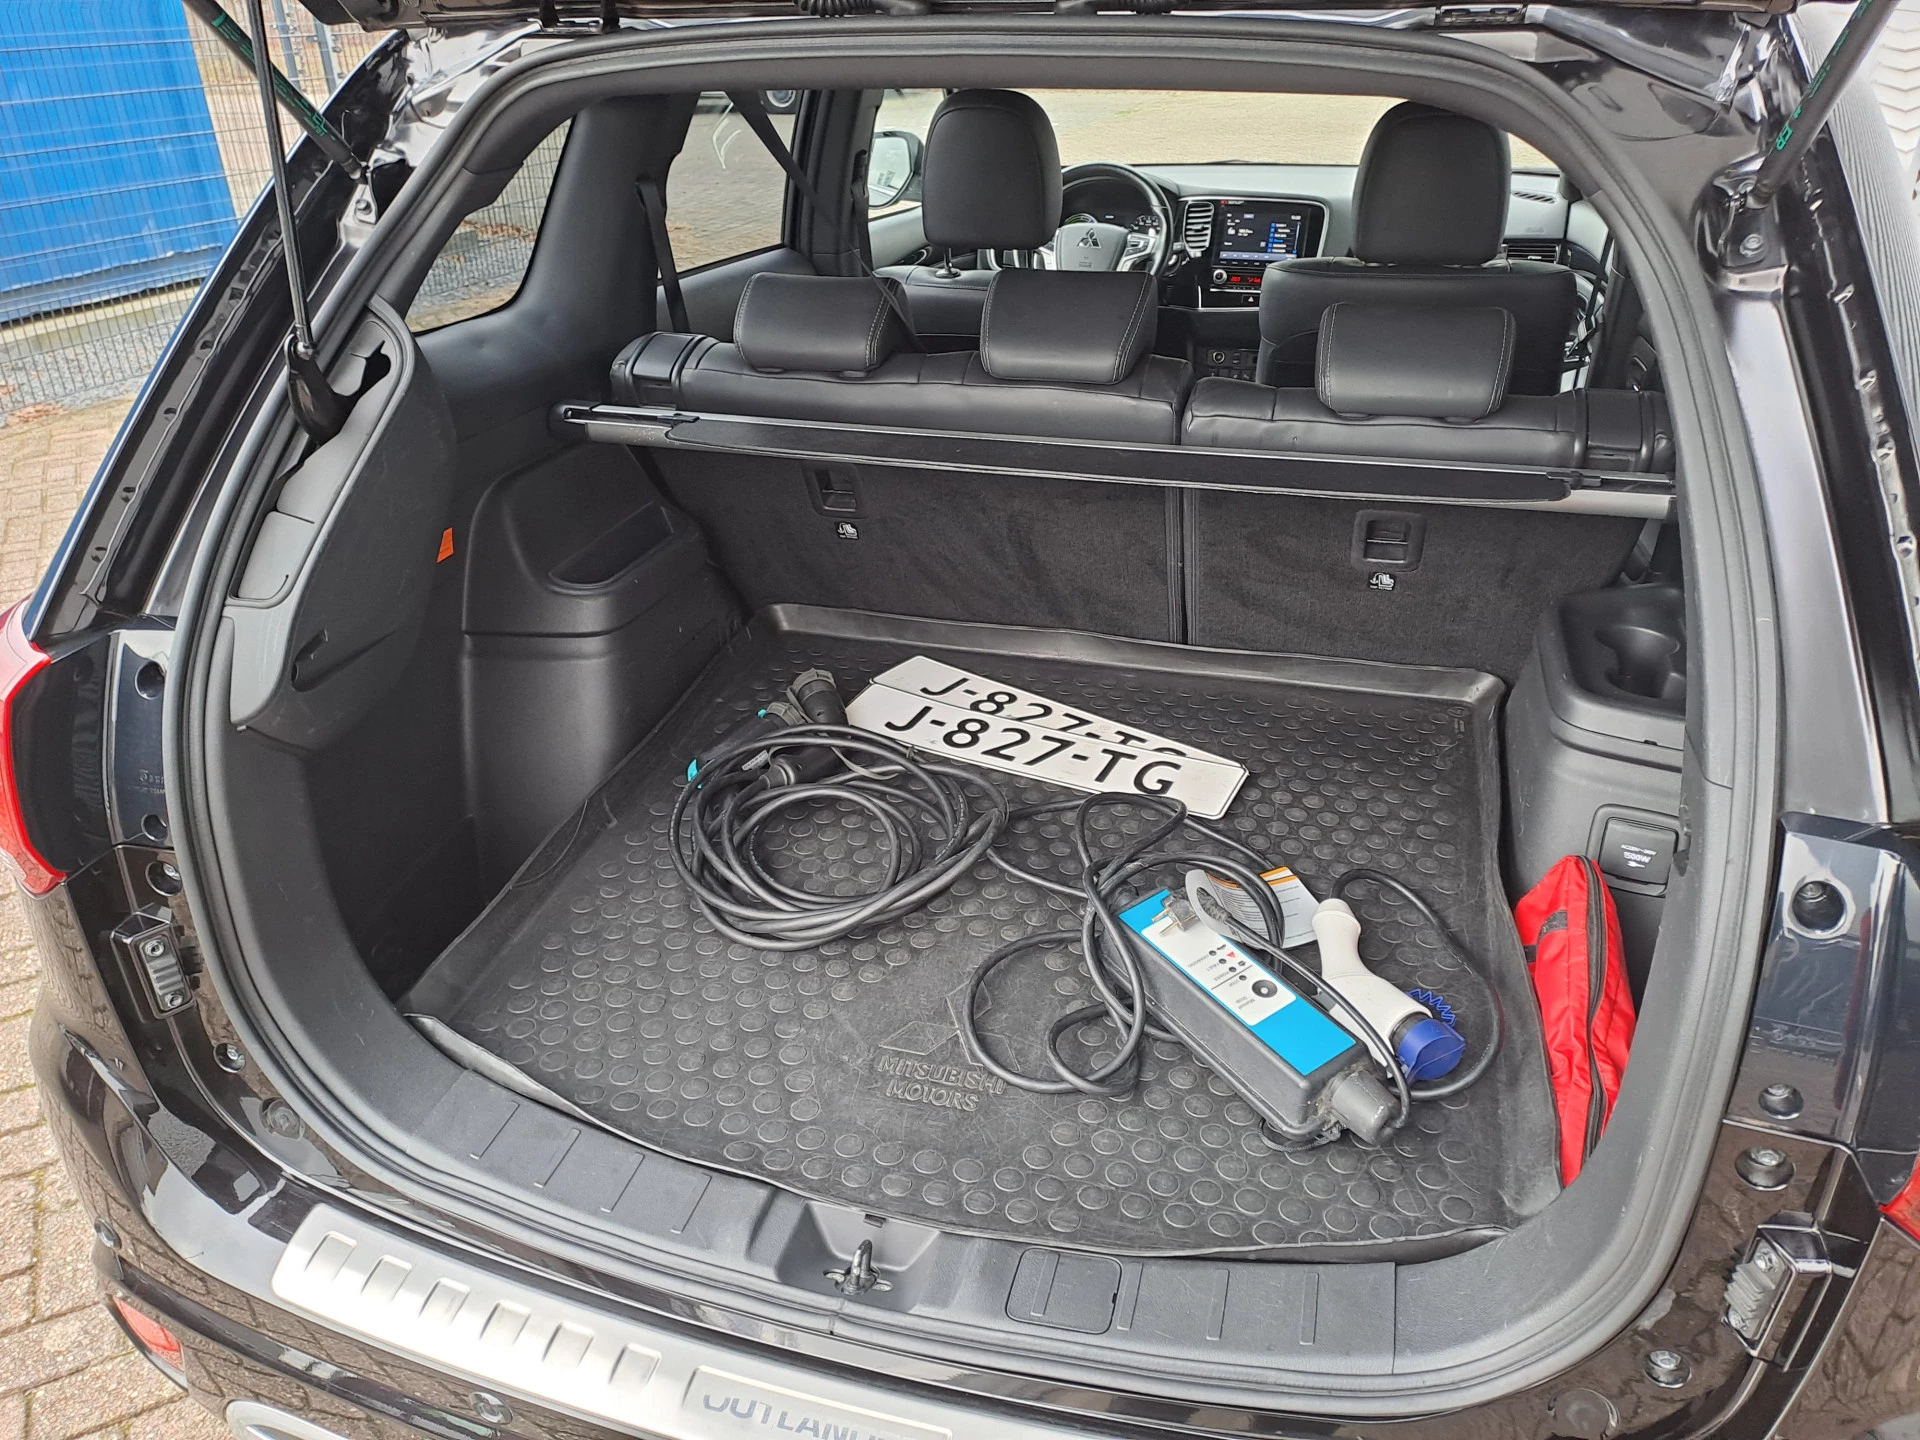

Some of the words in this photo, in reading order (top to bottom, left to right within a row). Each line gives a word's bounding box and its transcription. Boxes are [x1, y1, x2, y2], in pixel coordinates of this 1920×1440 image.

[919, 677, 1187, 757] J-827-T
[884, 705, 1183, 795] J-827-TG
[877, 1055, 1008, 1095] MITSUBISHI
[885, 1079, 981, 1112] MOTORS
